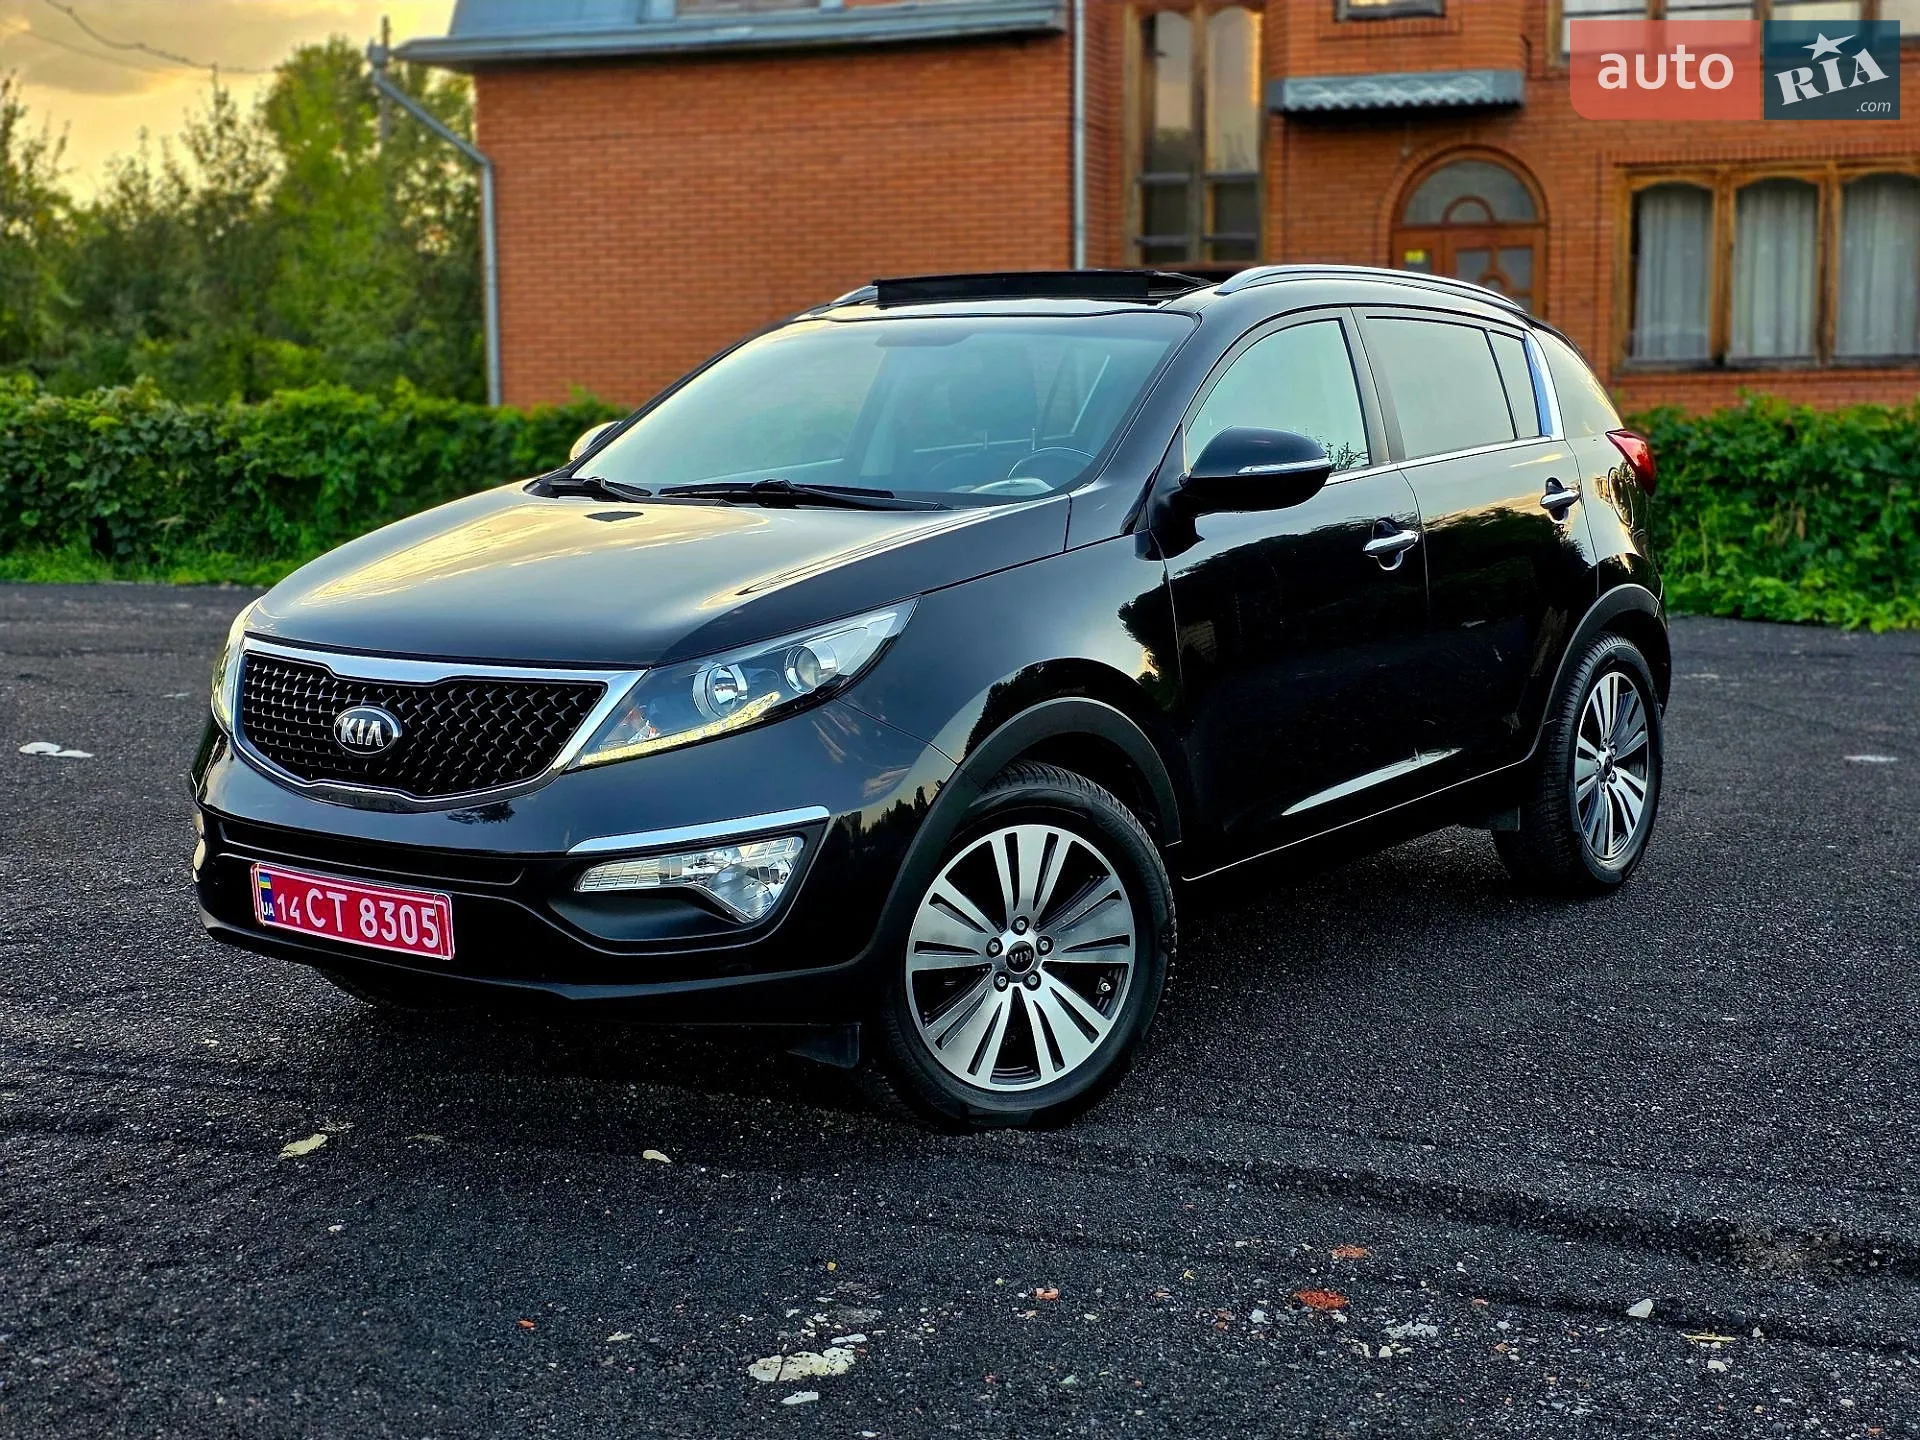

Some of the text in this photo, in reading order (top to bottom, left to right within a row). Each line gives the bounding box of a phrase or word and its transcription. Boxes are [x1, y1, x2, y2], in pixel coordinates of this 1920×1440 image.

[340, 717, 384, 747] KIA
[261, 900, 275, 917] UA
[359, 898, 439, 948] 8305
